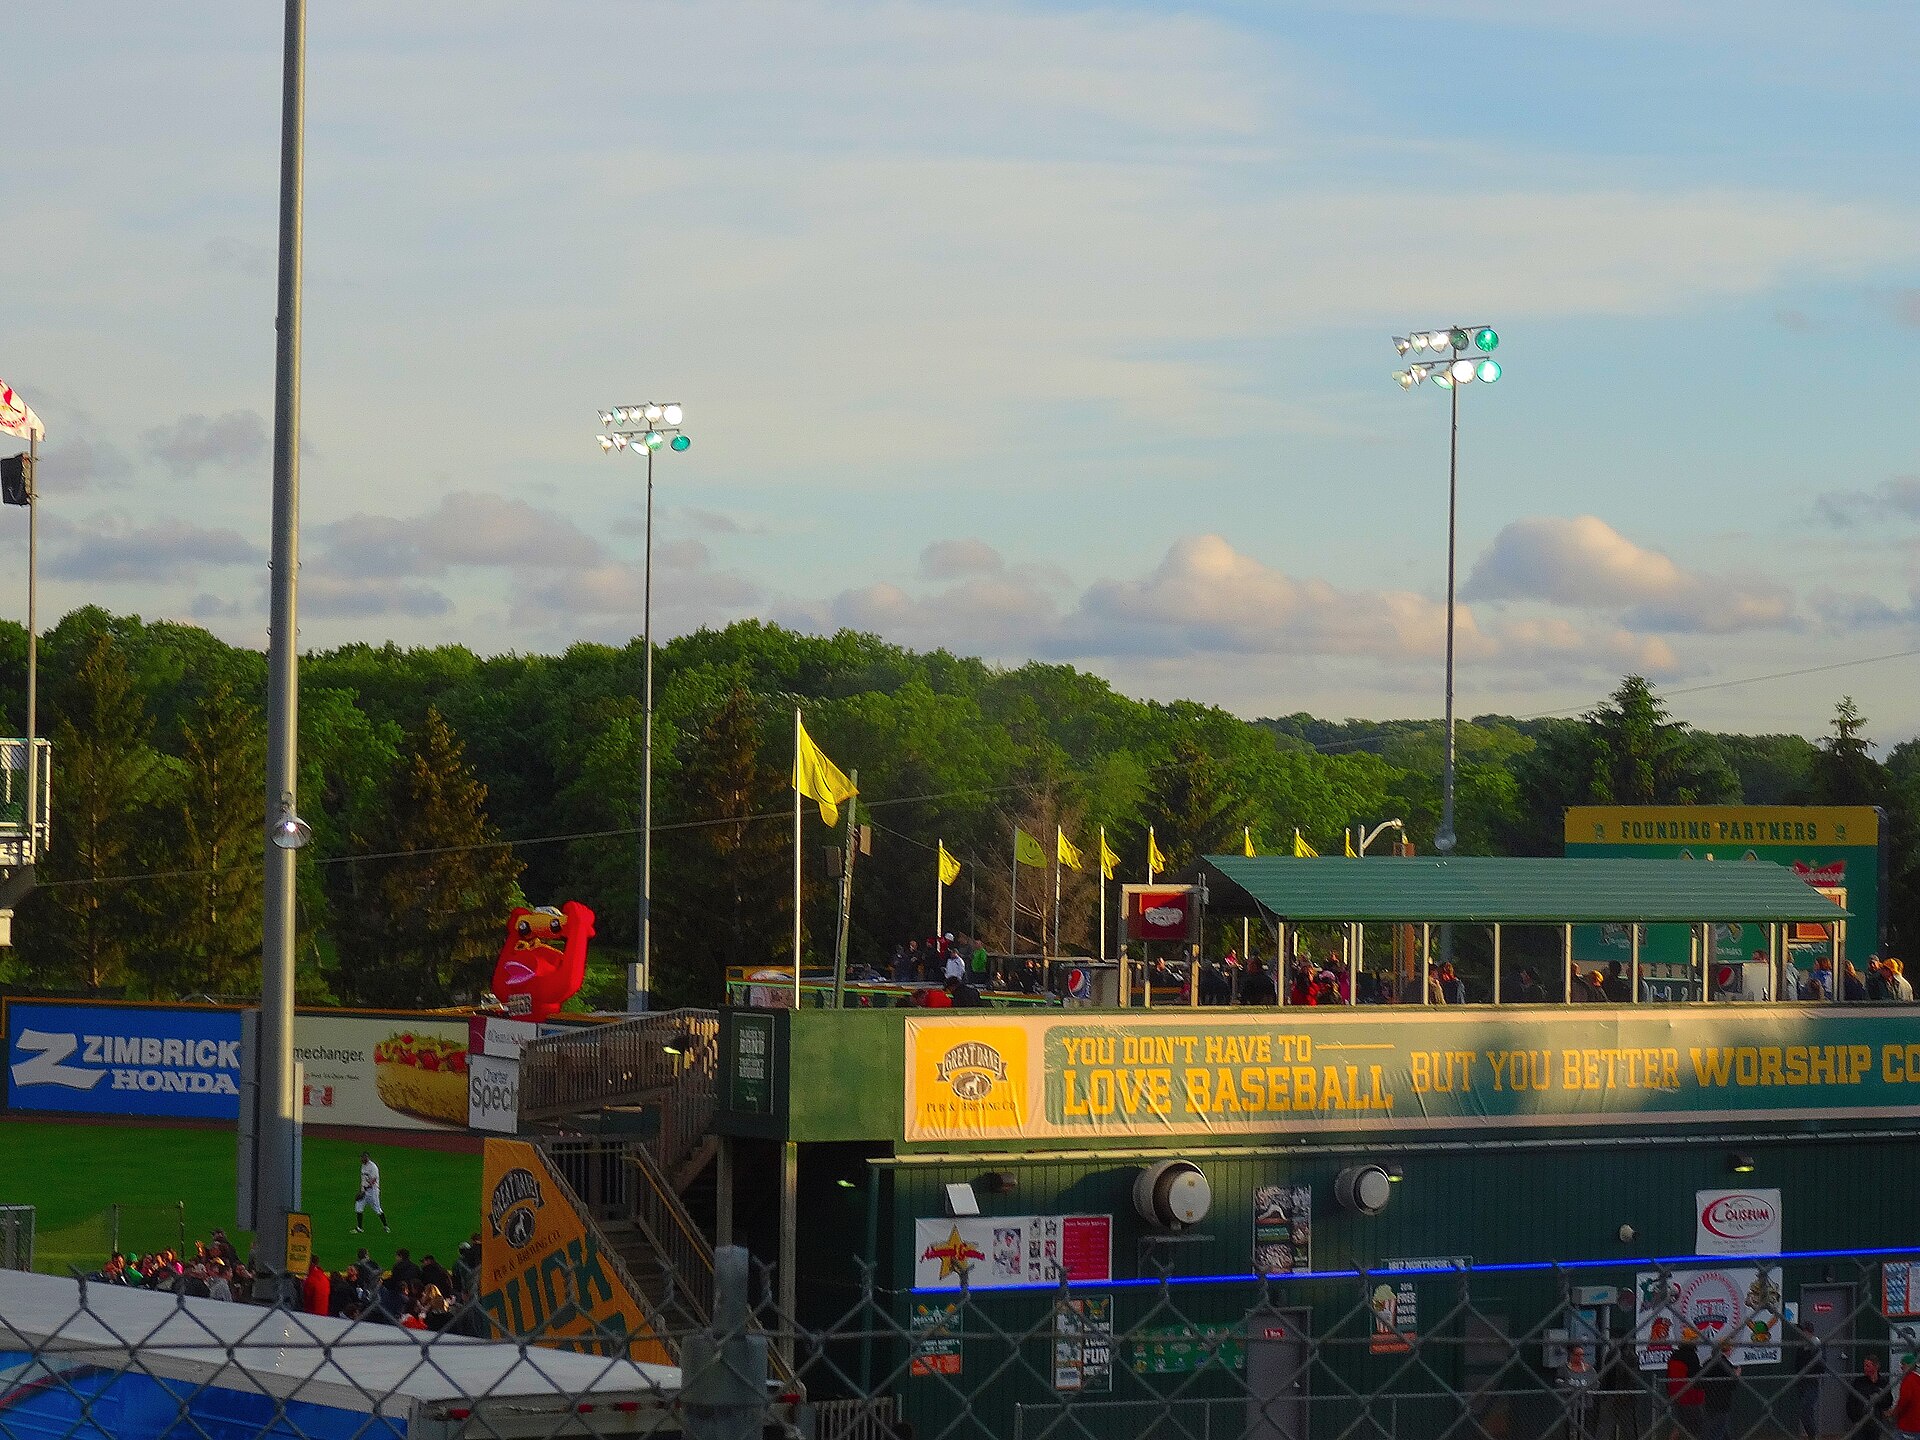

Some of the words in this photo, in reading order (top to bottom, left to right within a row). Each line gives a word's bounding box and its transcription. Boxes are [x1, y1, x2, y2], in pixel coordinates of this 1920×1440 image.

[1621, 821, 1711, 839] FOUNDING
[1719, 821, 1817, 840] PARTNERS
[83, 1035, 240, 1068] ZIMBRICK
[944, 1043, 976, 1072] GREAT
[977, 1044, 1001, 1073] DANE
[1063, 1037, 1114, 1065] YOU
[1123, 1036, 1198, 1065] DON'T
[1205, 1035, 1272, 1064] HAVE
[1278, 1034, 1312, 1063] TO
[111, 1069, 239, 1095] HONDA
[1410, 1051, 1477, 1092] BUT
[1486, 1050, 1551, 1091] YOU
[1562, 1048, 1680, 1089] BETTER
[1689, 1045, 1872, 1087] WORSHIP
[1063, 1068, 1171, 1115] LOVE
[1184, 1065, 1393, 1113] BASEBALL
[1083, 1347, 1110, 1364] FUN
